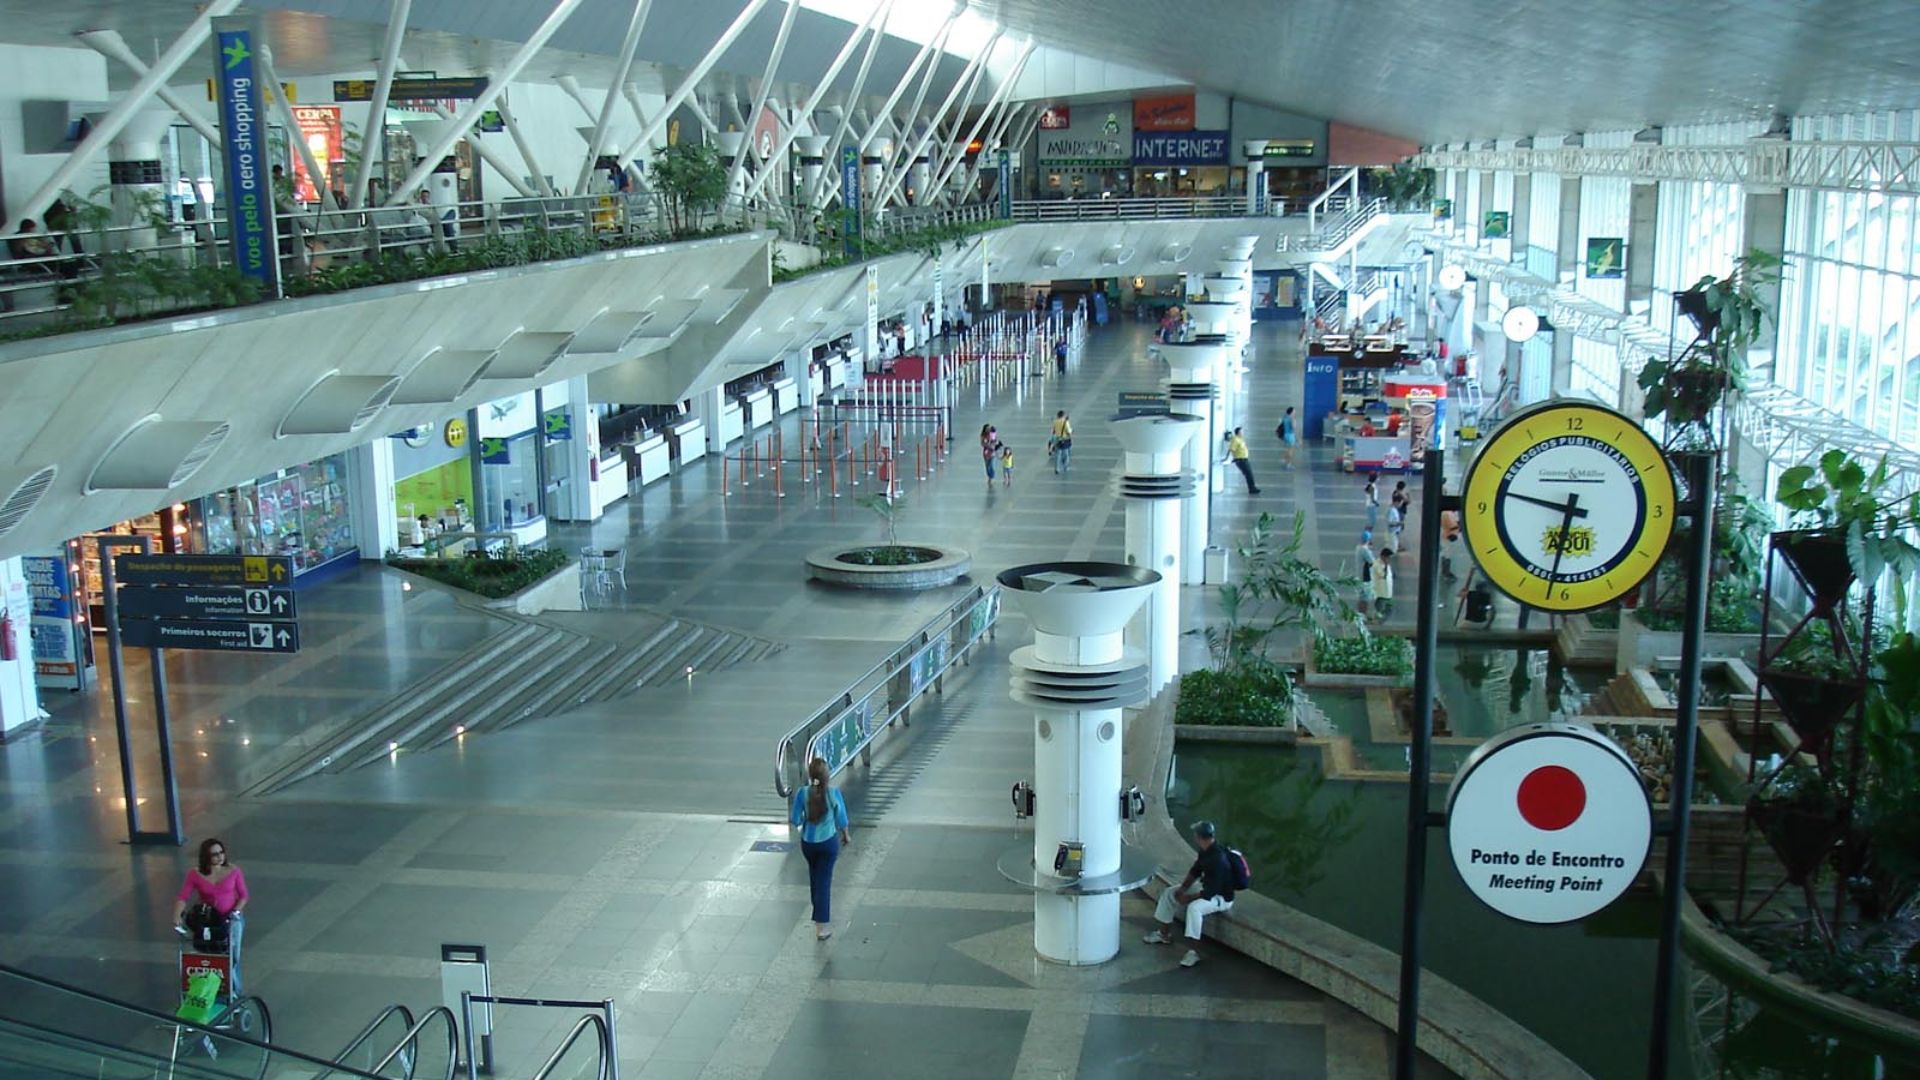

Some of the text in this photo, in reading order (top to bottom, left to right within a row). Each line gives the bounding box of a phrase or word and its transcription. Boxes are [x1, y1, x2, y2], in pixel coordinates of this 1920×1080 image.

[1135, 138, 1225, 158] INTERNET
[230, 77, 263, 269] voe pelo aero shopping
[1566, 417, 1583, 431] 12
[1478, 501, 1487, 515] 9
[1653, 505, 1663, 518] 3
[1547, 537, 1590, 553] AQUI
[185, 595, 243, 605] Informações
[1560, 588, 1569, 601] 6
[160, 627, 247, 638] Primeiros socorros
[1470, 849, 1625, 868] Ponto de Encontro
[1489, 874, 1603, 893] Meeting Point
